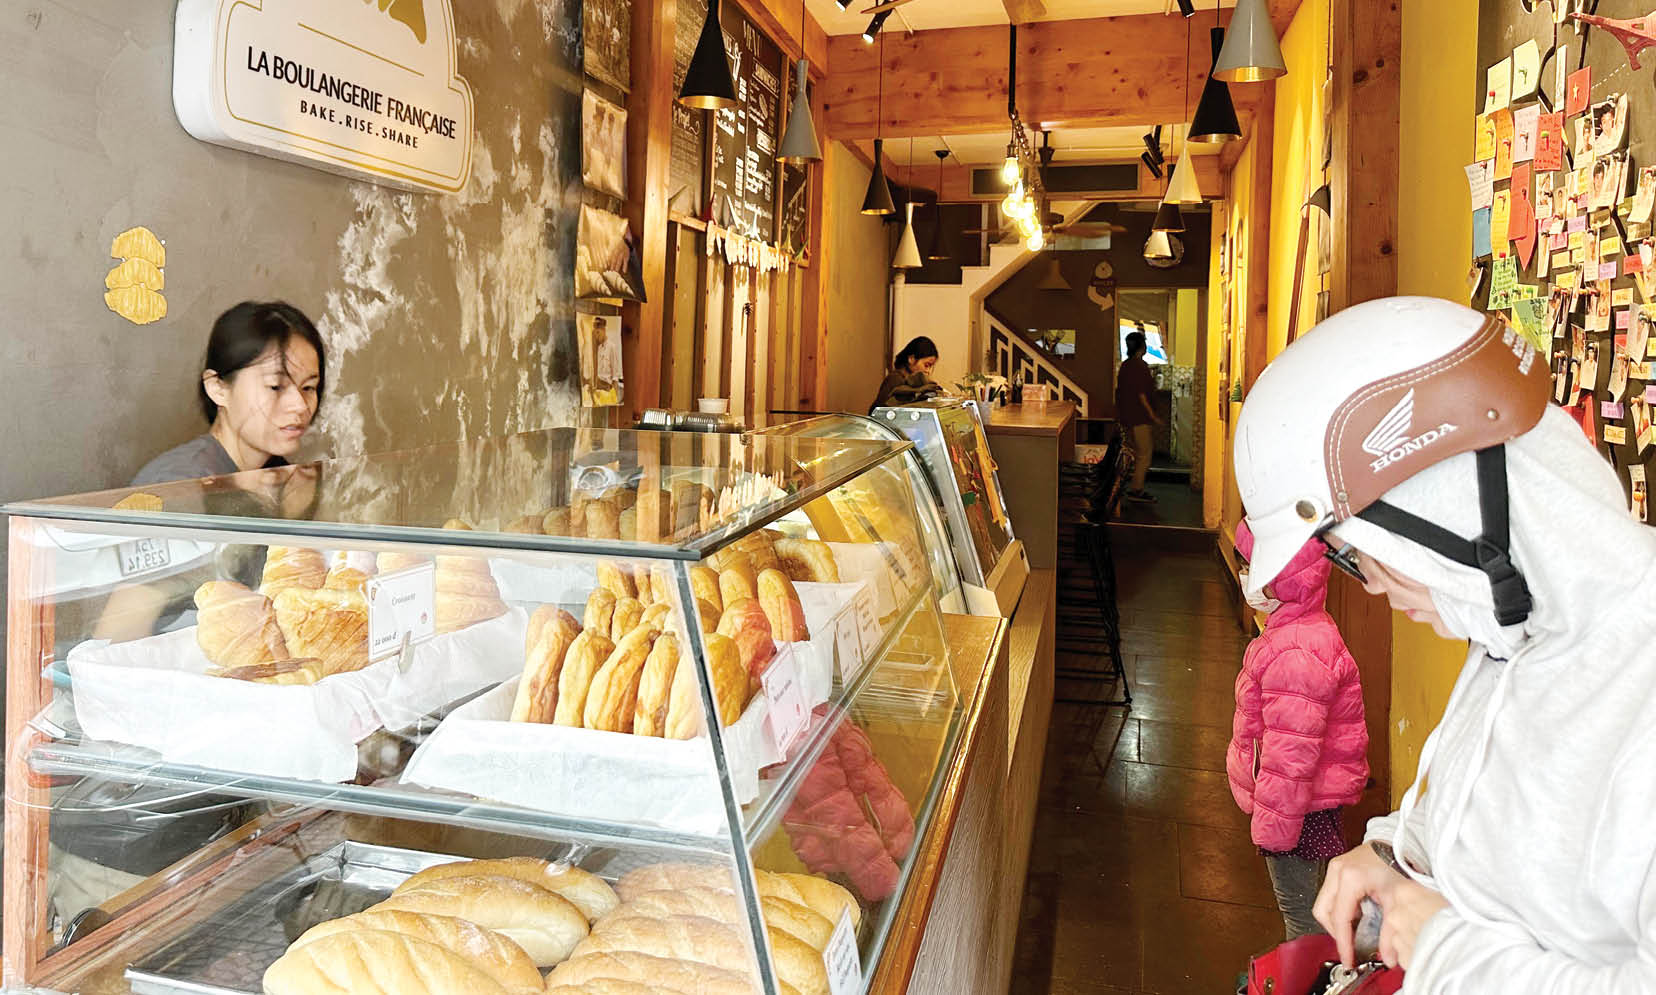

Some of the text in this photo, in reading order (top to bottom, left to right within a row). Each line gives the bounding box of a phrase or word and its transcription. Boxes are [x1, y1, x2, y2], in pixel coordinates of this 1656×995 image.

[248, 46, 457, 139] LA BOULANGERIE FRANÇAISE
[1369, 423, 1458, 472] HONDA
